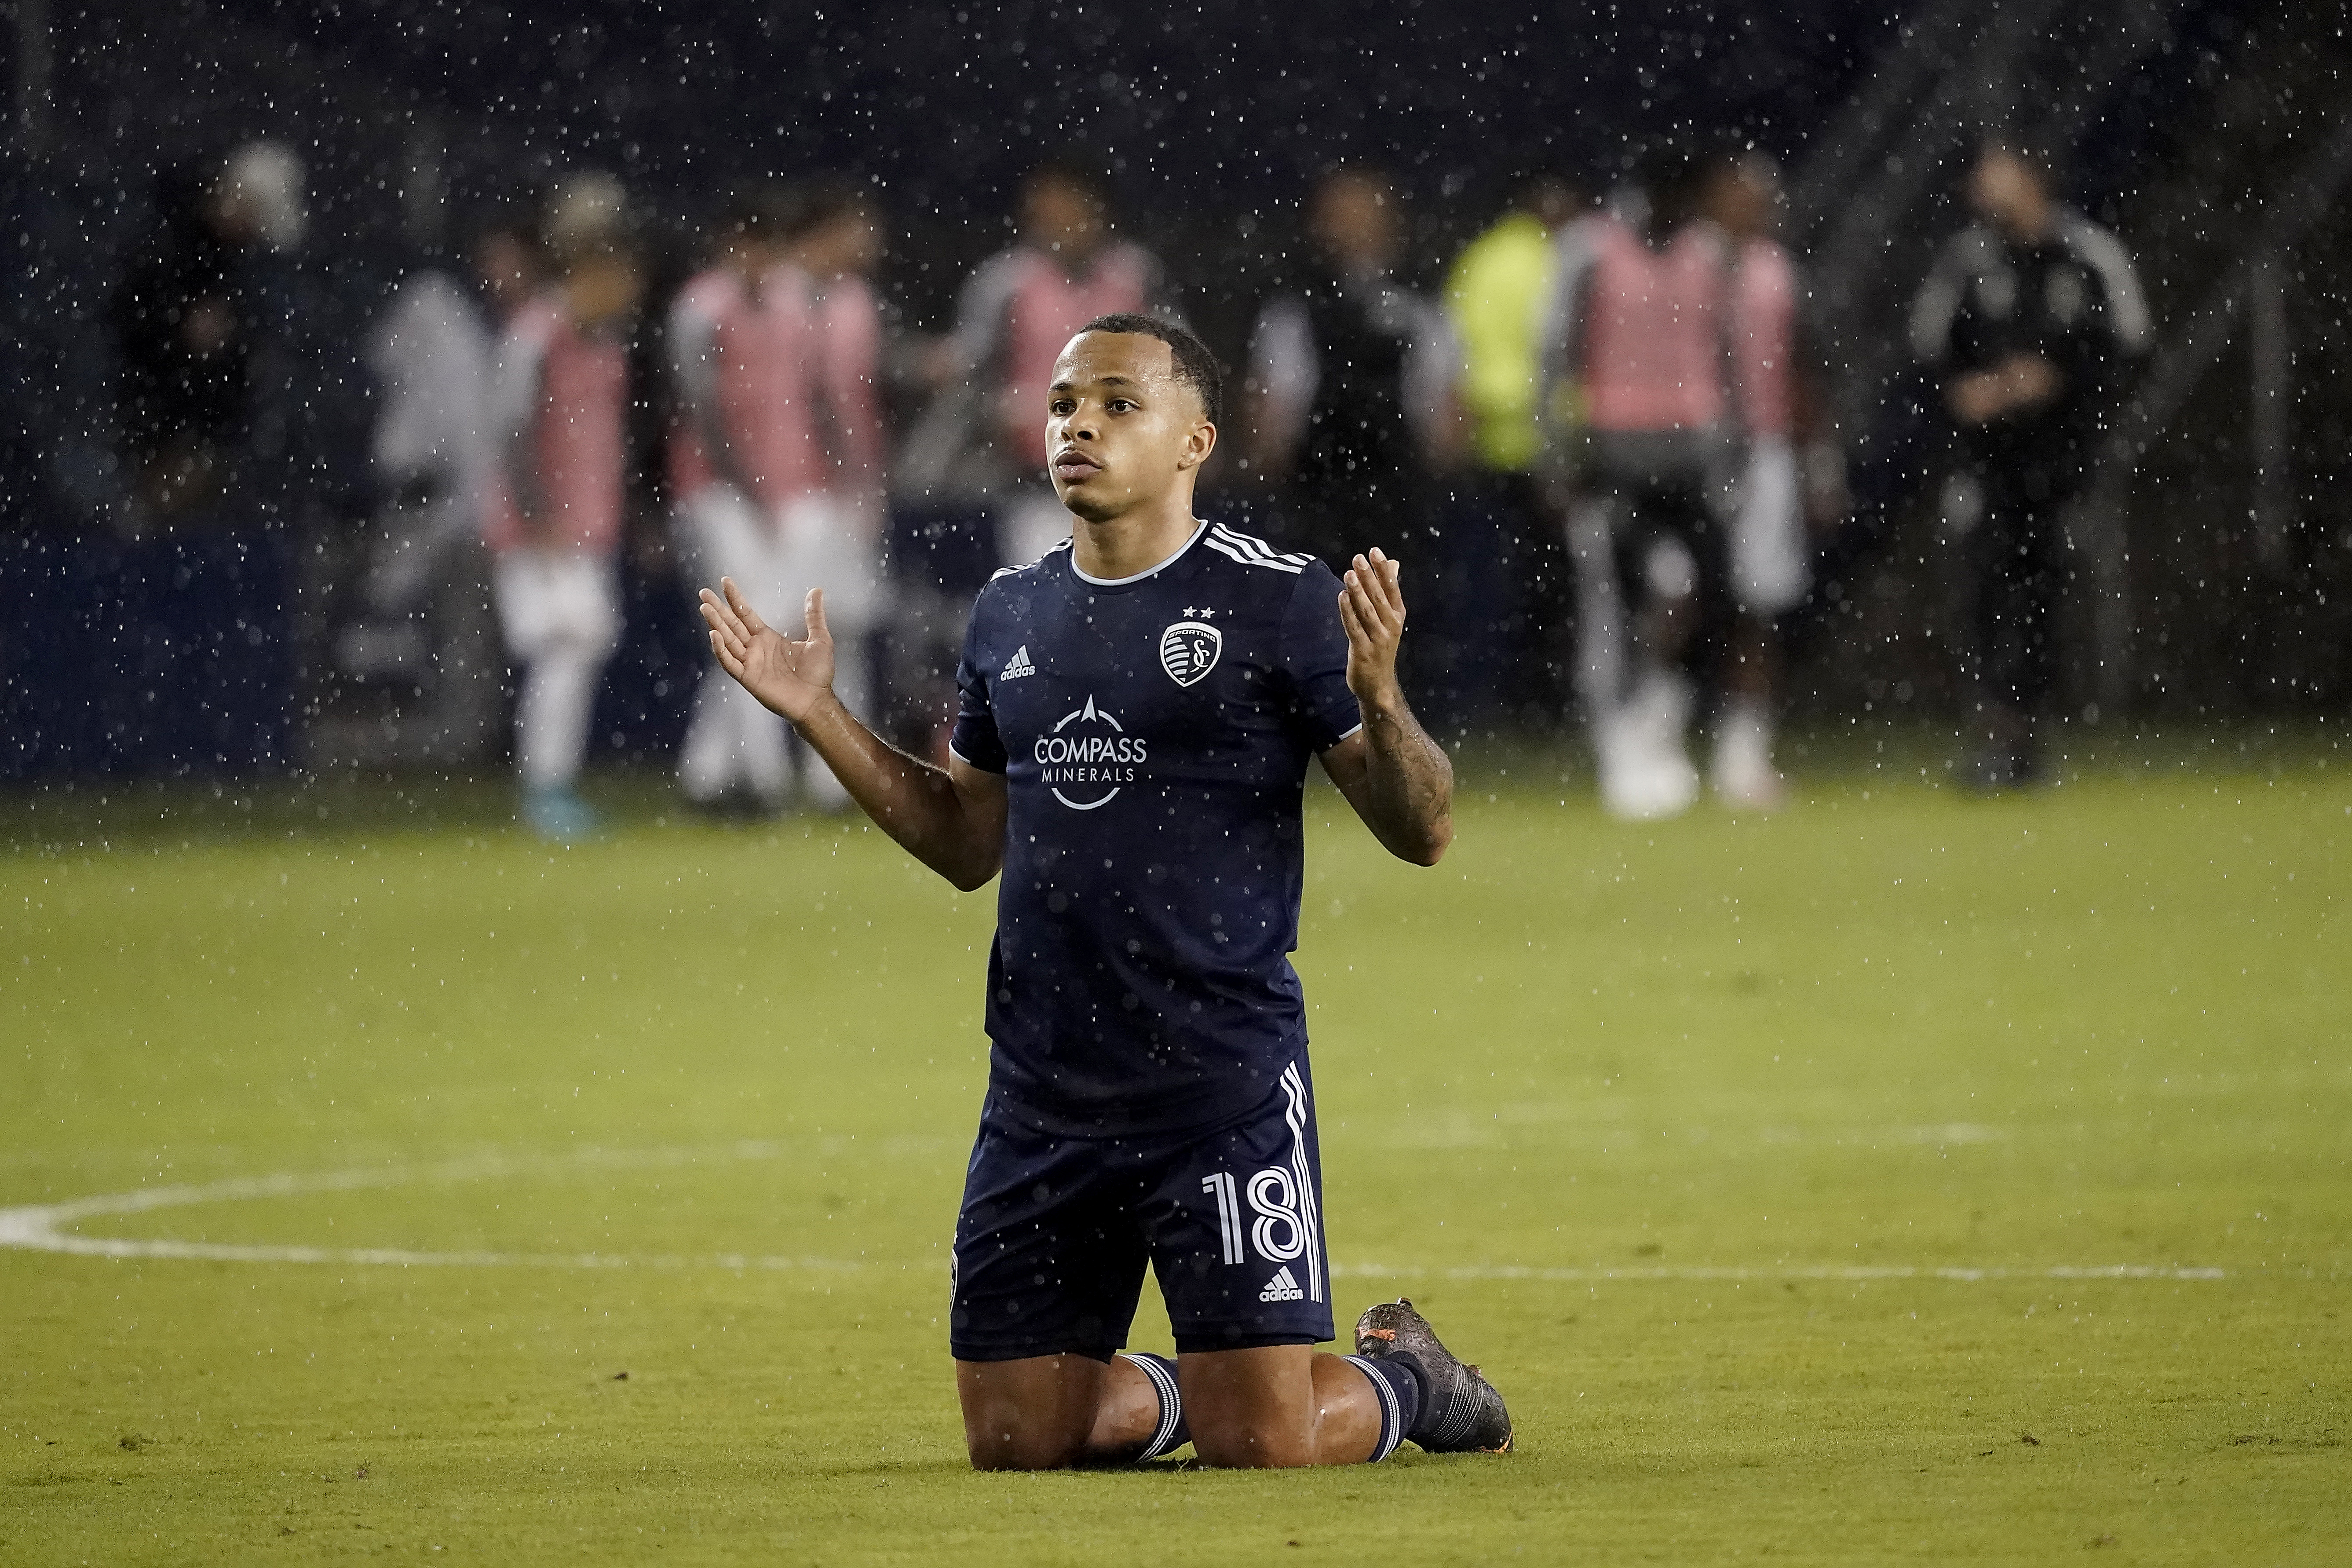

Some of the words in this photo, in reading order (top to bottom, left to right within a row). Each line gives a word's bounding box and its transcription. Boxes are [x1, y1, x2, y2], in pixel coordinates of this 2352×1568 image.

[1168, 629, 1216, 643] SPORTING
[1000, 665, 1036, 681] adidas
[1034, 737, 1147, 764] COMPASS
[1041, 768, 1134, 782] MINERALS
[1202, 1166, 1304, 1265] 18
[1259, 1288, 1304, 1302] adidas
